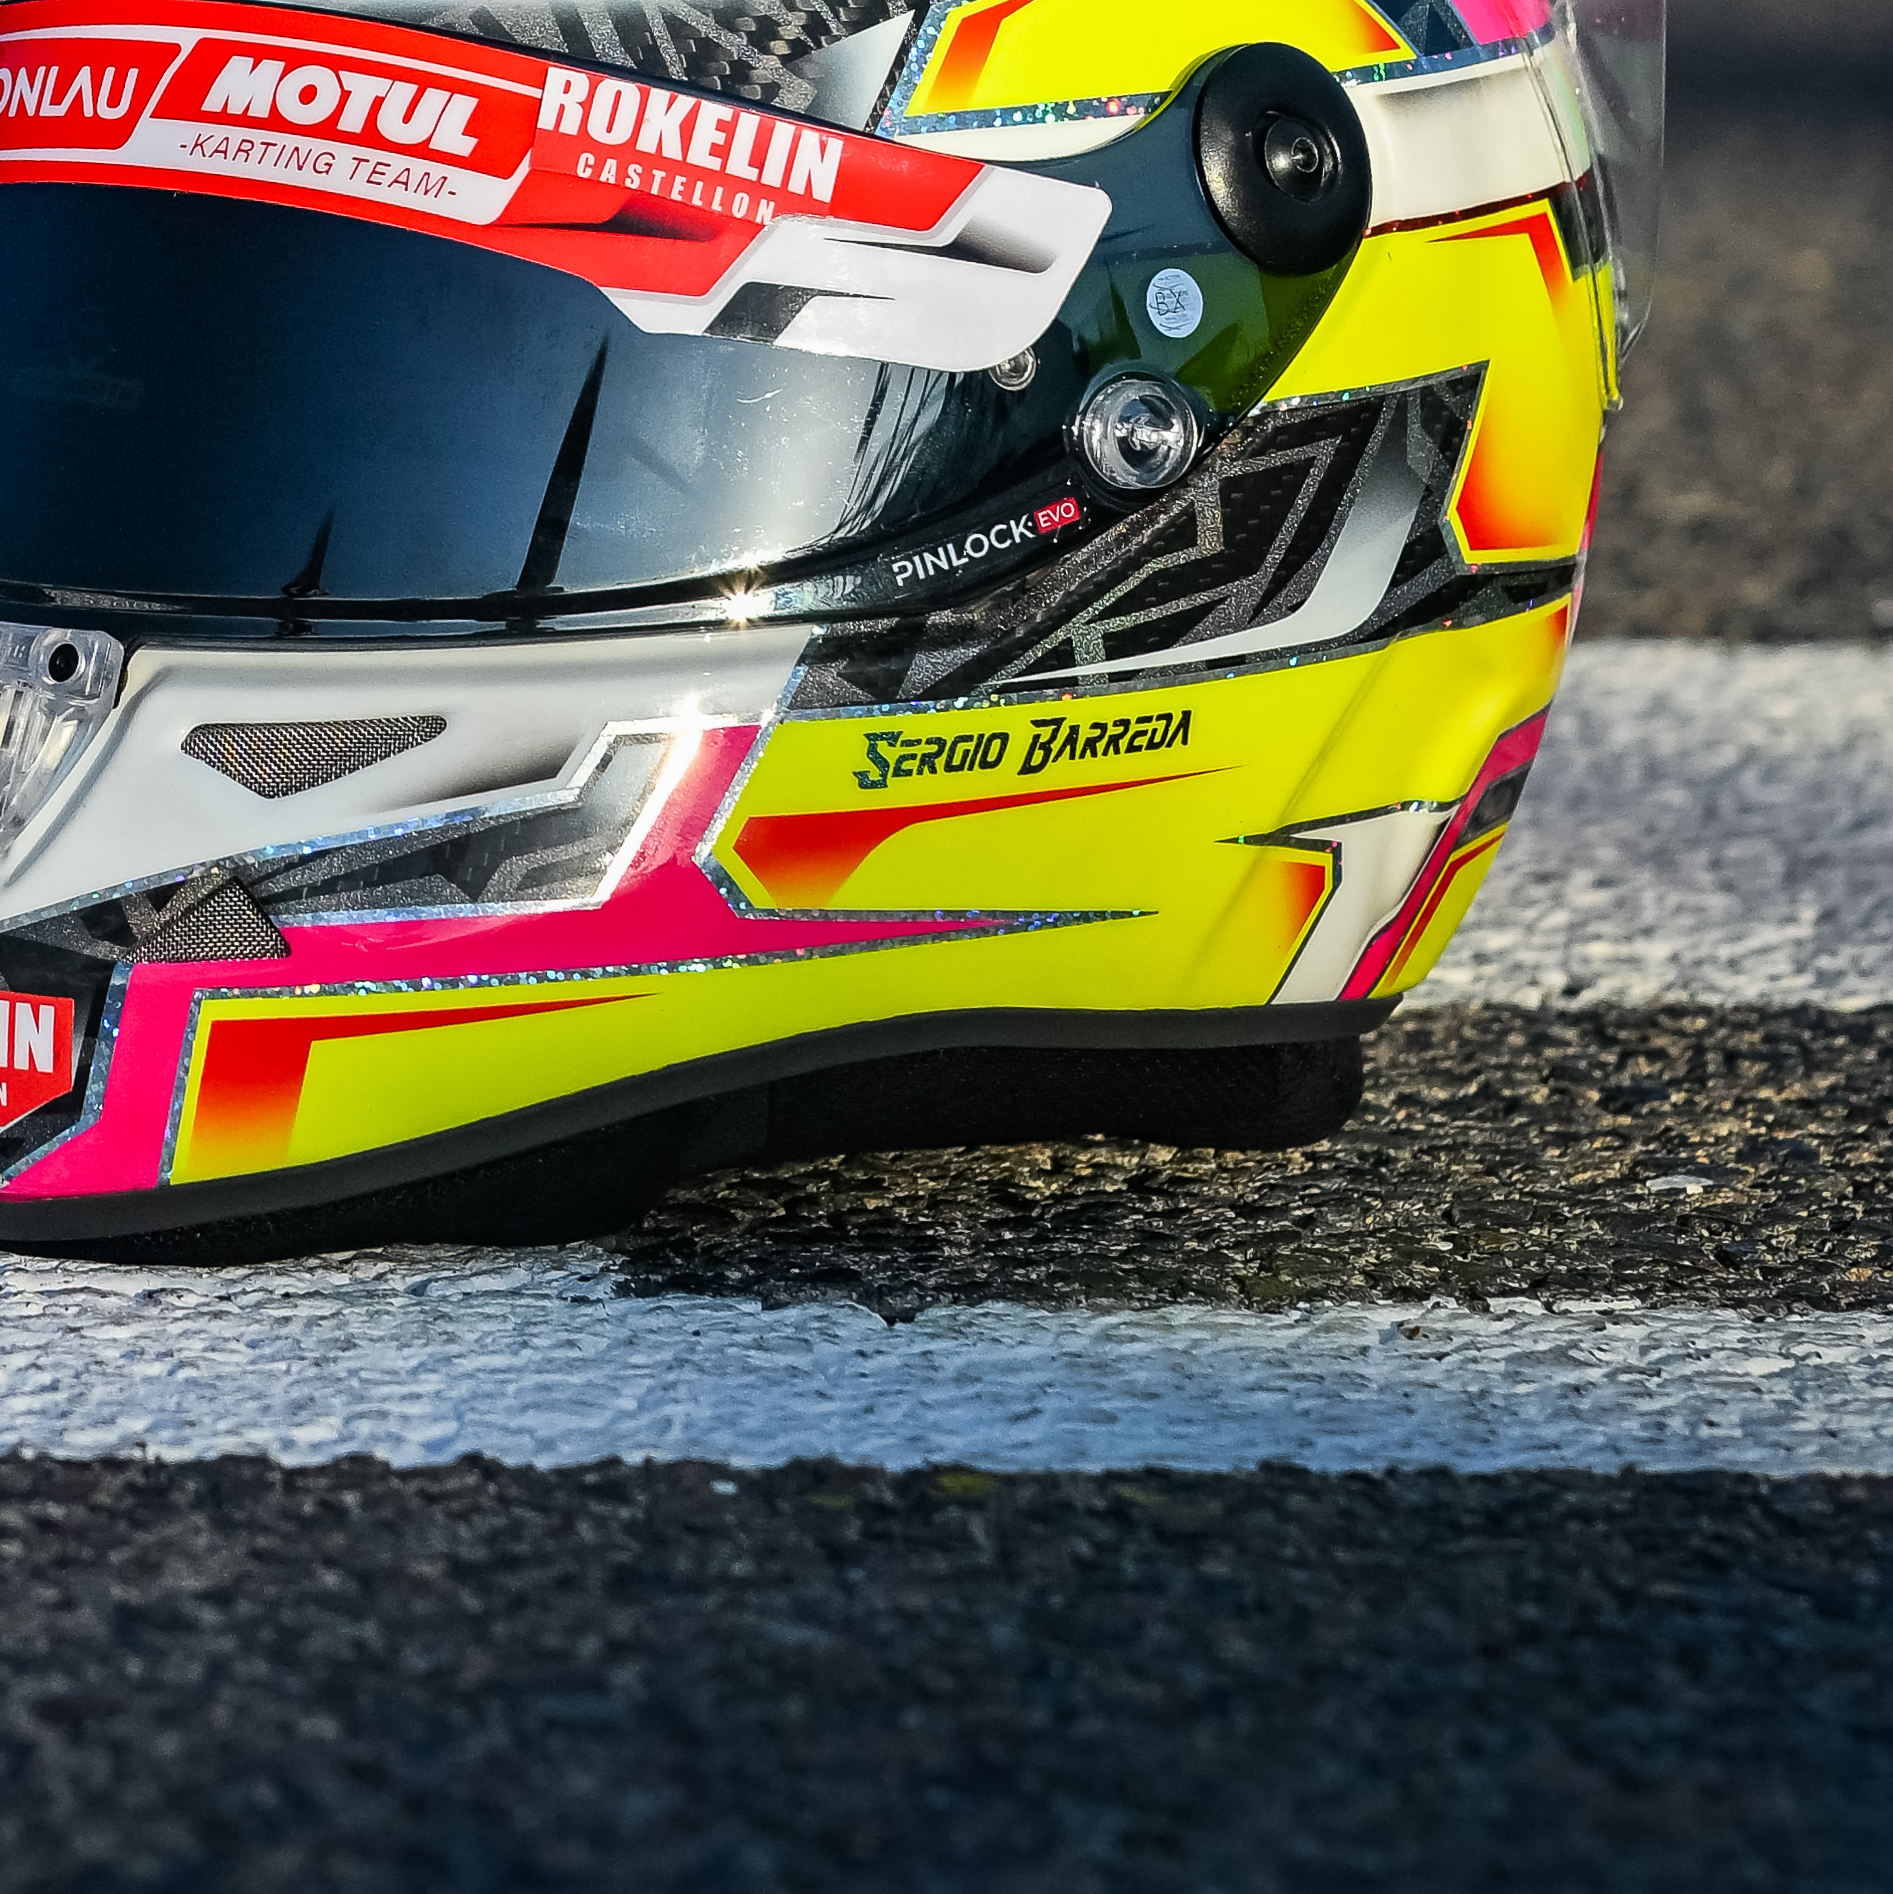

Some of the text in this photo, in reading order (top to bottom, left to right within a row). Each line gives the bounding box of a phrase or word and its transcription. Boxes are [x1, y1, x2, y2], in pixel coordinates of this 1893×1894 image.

[201, 55, 480, 158] MOTUL
[537, 66, 844, 203] ROKELIN
[577, 152, 777, 225] CASTELLON
[892, 501, 1076, 588] PINLOCK EVO
